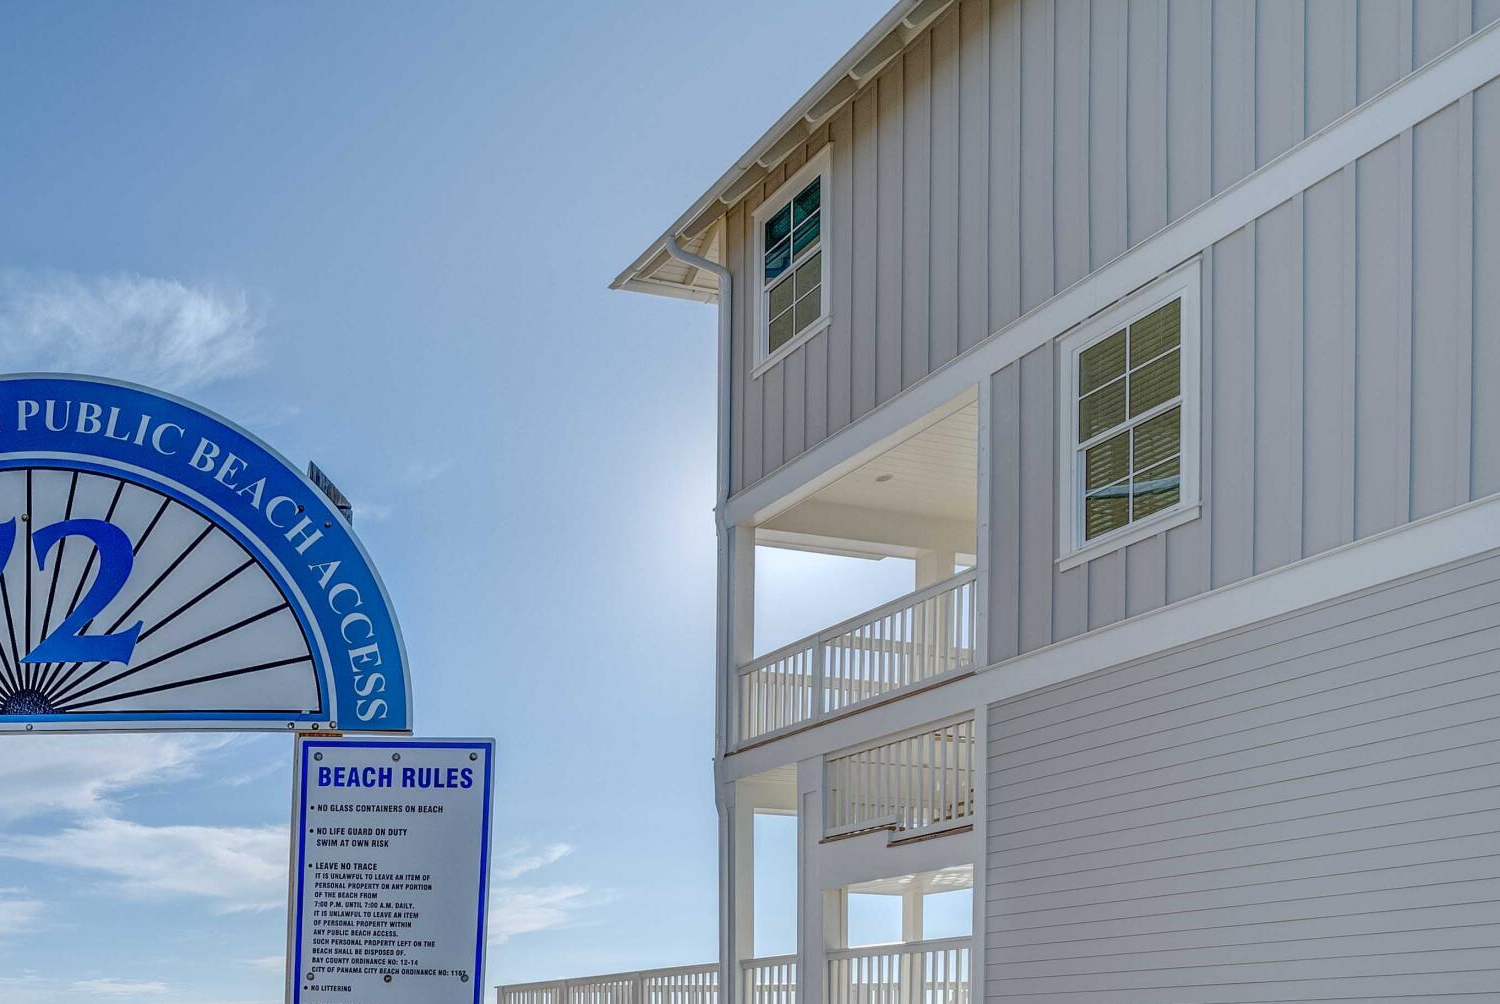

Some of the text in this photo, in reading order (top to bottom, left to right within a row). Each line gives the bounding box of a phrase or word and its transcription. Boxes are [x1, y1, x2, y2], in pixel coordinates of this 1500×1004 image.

[17, 399, 186, 456] PUBLIC
[188, 437, 325, 556] BEACH
[308, 560, 388, 721] ACCESS
[318, 767, 472, 788] BEACH RULES
